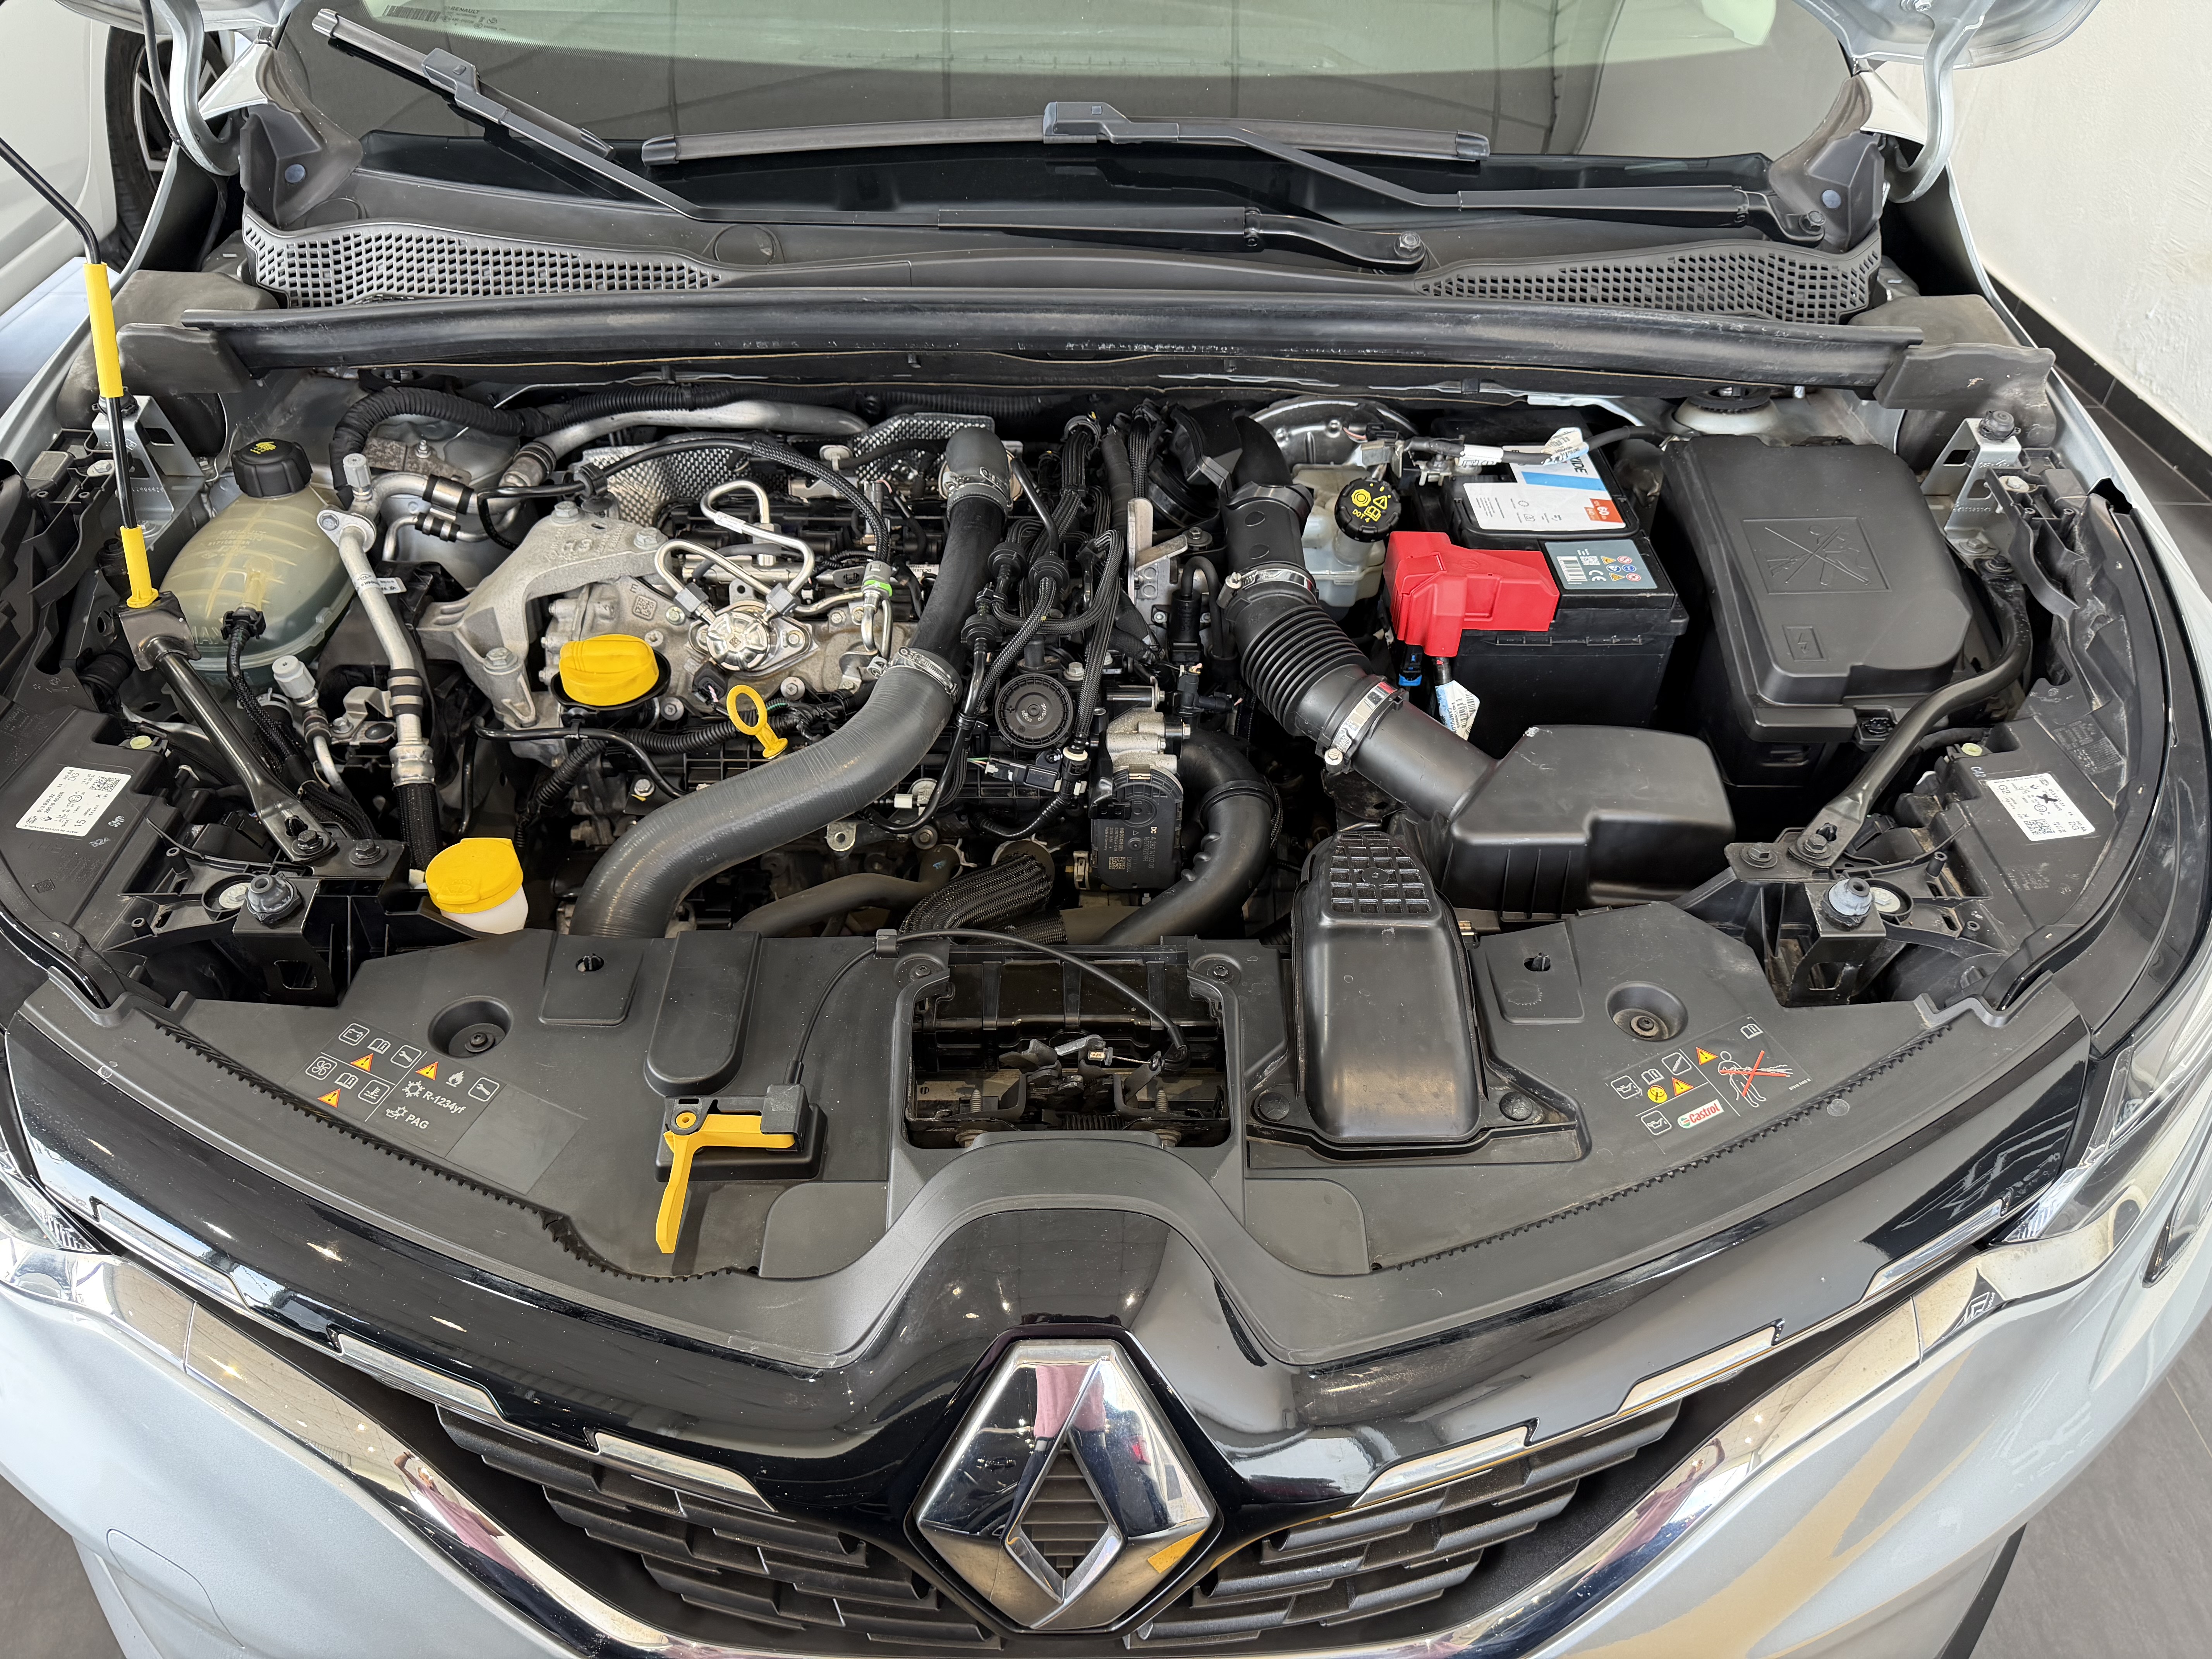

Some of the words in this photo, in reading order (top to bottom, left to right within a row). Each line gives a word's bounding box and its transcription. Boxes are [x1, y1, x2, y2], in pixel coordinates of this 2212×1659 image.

[1352, 509, 1366, 519] DOT
[1597, 506, 1609, 515] 60
[68, 773, 80, 781] DG
[1998, 785, 2011, 794] G2
[74, 819, 86, 828] 15
[2067, 821, 2080, 830] DG
[422, 1090, 466, 1115] R-1234yf
[1689, 1103, 1720, 1124] Castrol
[405, 1114, 429, 1130] PAG
